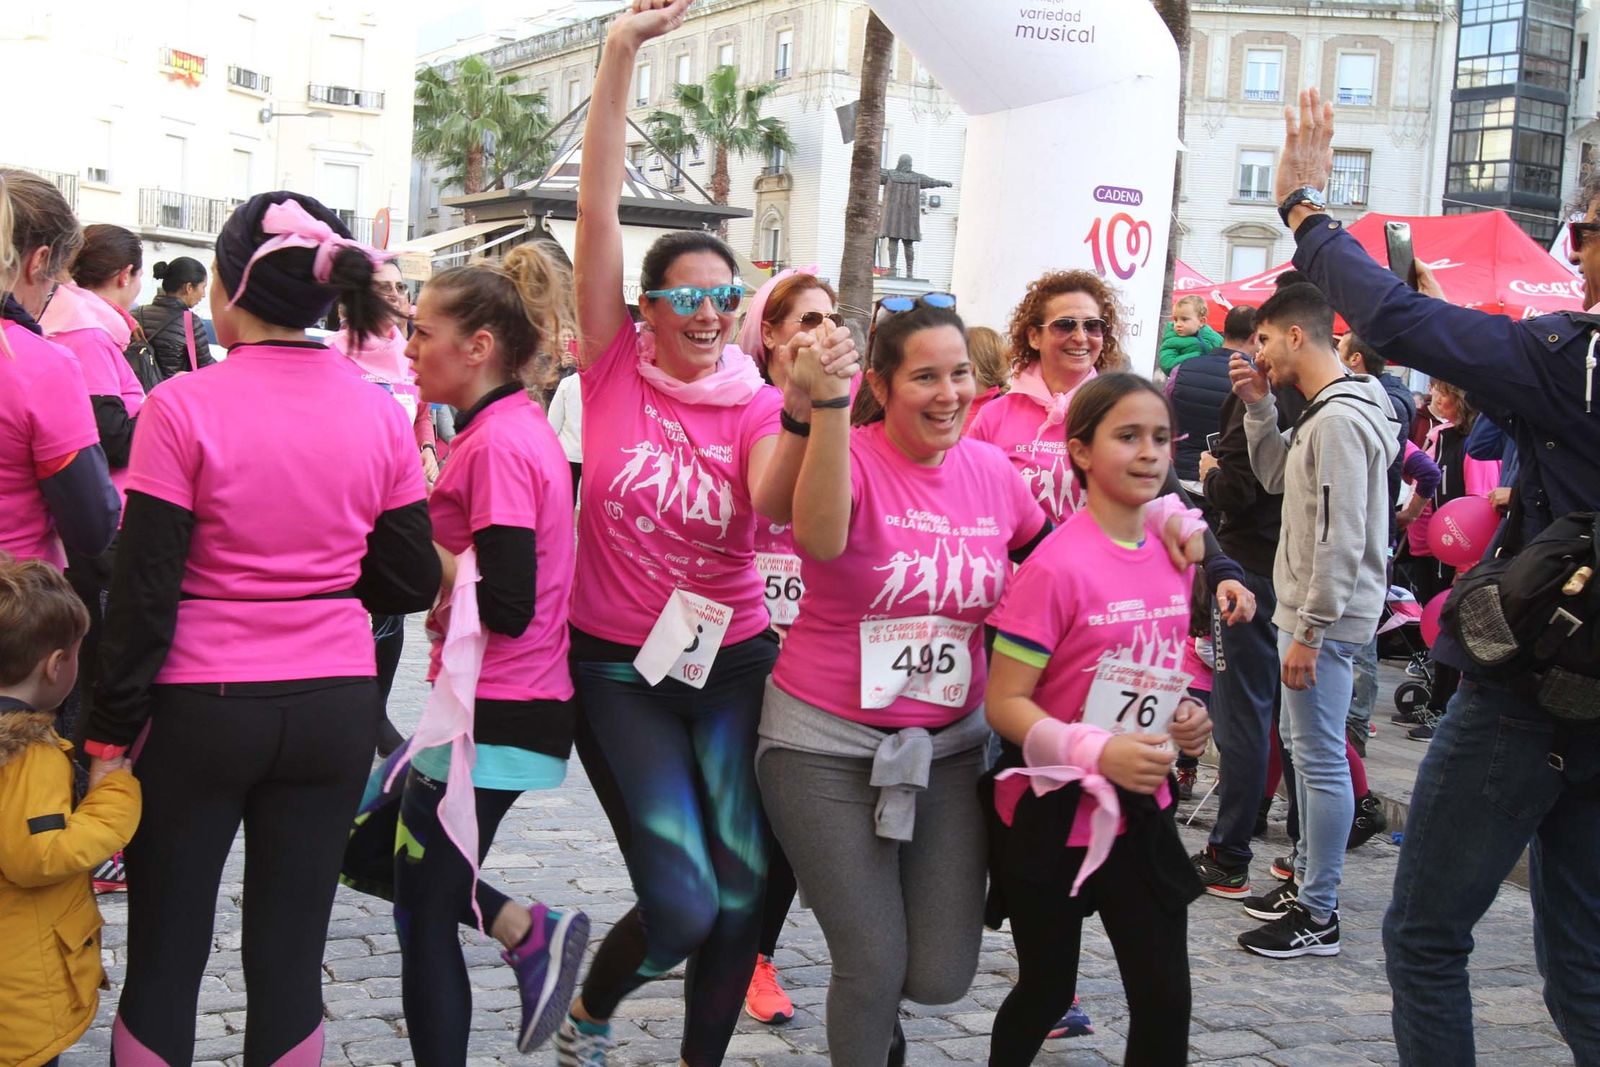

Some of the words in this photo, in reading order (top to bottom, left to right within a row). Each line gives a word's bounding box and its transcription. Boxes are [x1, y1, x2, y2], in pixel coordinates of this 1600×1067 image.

[1020, 9, 1081, 22] variedad
[1015, 25, 1095, 43] musical
[1096, 188, 1141, 204] CADENA
[709, 444, 734, 455] PINK
[885, 514, 900, 527] DE
[902, 517, 916, 529] LA
[764, 575, 802, 602] 56
[705, 604, 726, 619] PINK
[868, 633, 881, 644] DE
[883, 633, 895, 642] LA
[892, 643, 956, 677] 495
[1117, 690, 1159, 728] 76
